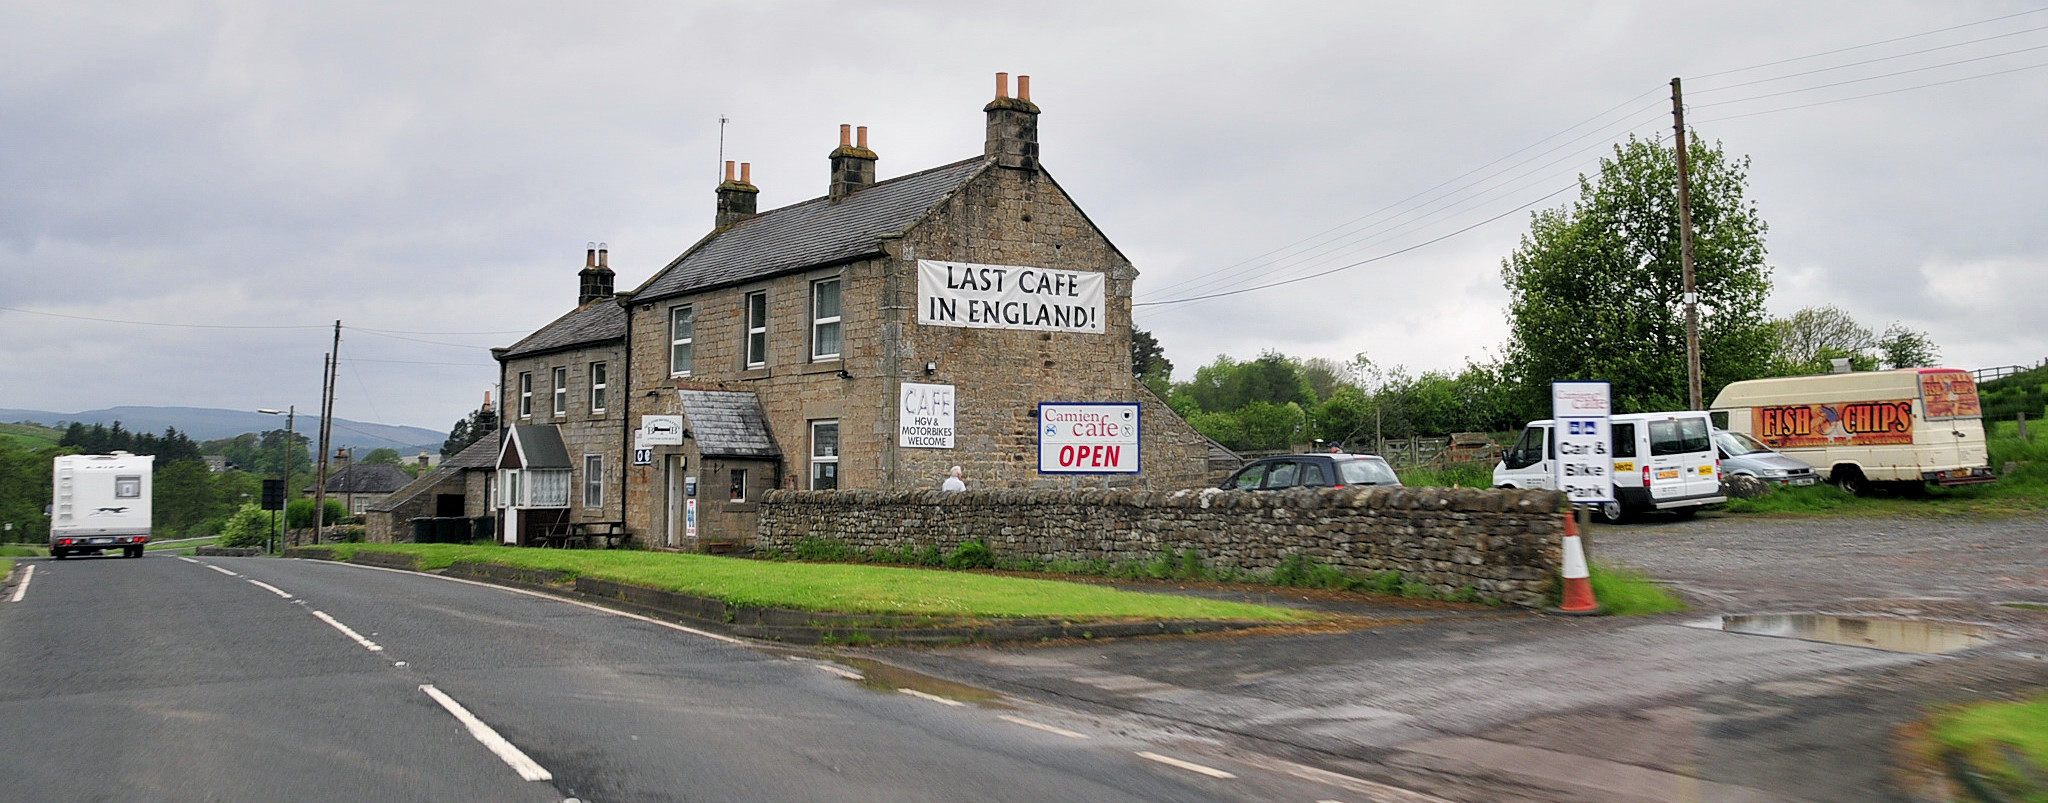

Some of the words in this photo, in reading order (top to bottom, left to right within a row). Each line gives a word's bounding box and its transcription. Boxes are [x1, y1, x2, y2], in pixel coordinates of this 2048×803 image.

[946, 266, 1007, 293] LAST
[1018, 270, 1079, 297] CAFE
[929, 296, 956, 322] IN
[968, 299, 1097, 329] ENGLAND!
[904, 388, 950, 417] CAFE
[914, 416, 933, 426] HGV
[933, 417, 939, 426] &
[1044, 408, 1100, 422] Camien
[1762, 407, 1811, 436] FISH
[1842, 401, 1913, 434] CHIPS
[901, 426, 953, 437] MOTORBIKES
[1072, 414, 1119, 437] cafe
[907, 436, 947, 446] WELCOME
[1560, 441, 1591, 455] Car
[1593, 440, 1608, 455] &
[1059, 445, 1121, 467] OPEN
[1564, 462, 1605, 477] Bike
[1614, 462, 1634, 471] Hertz
[1564, 484, 1606, 498] Park
